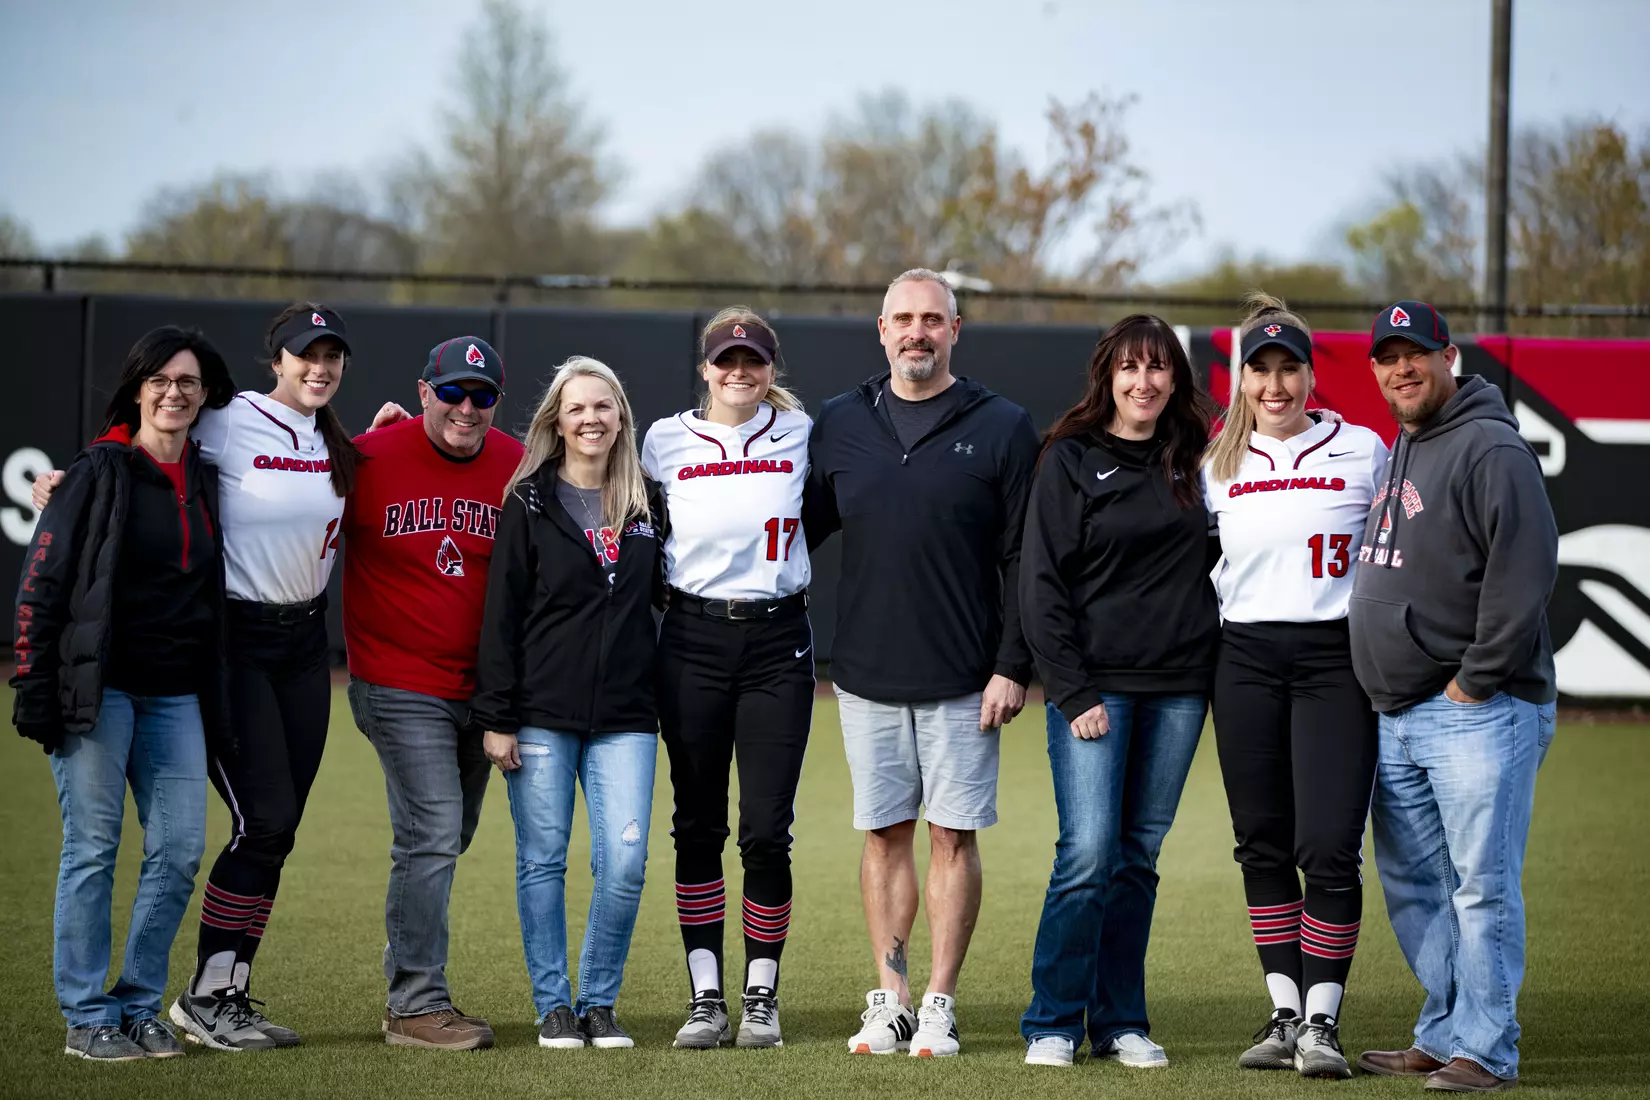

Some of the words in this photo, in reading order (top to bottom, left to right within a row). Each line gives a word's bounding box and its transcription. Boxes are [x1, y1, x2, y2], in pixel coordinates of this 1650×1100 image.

[677, 460, 794, 481] CARDINALS
[1228, 477, 1346, 498] CARDINALS
[382, 497, 447, 538] BALL
[451, 498, 503, 540] STAT
[764, 517, 800, 561] 17
[23, 531, 54, 592] BALL
[1307, 533, 1353, 578] 13
